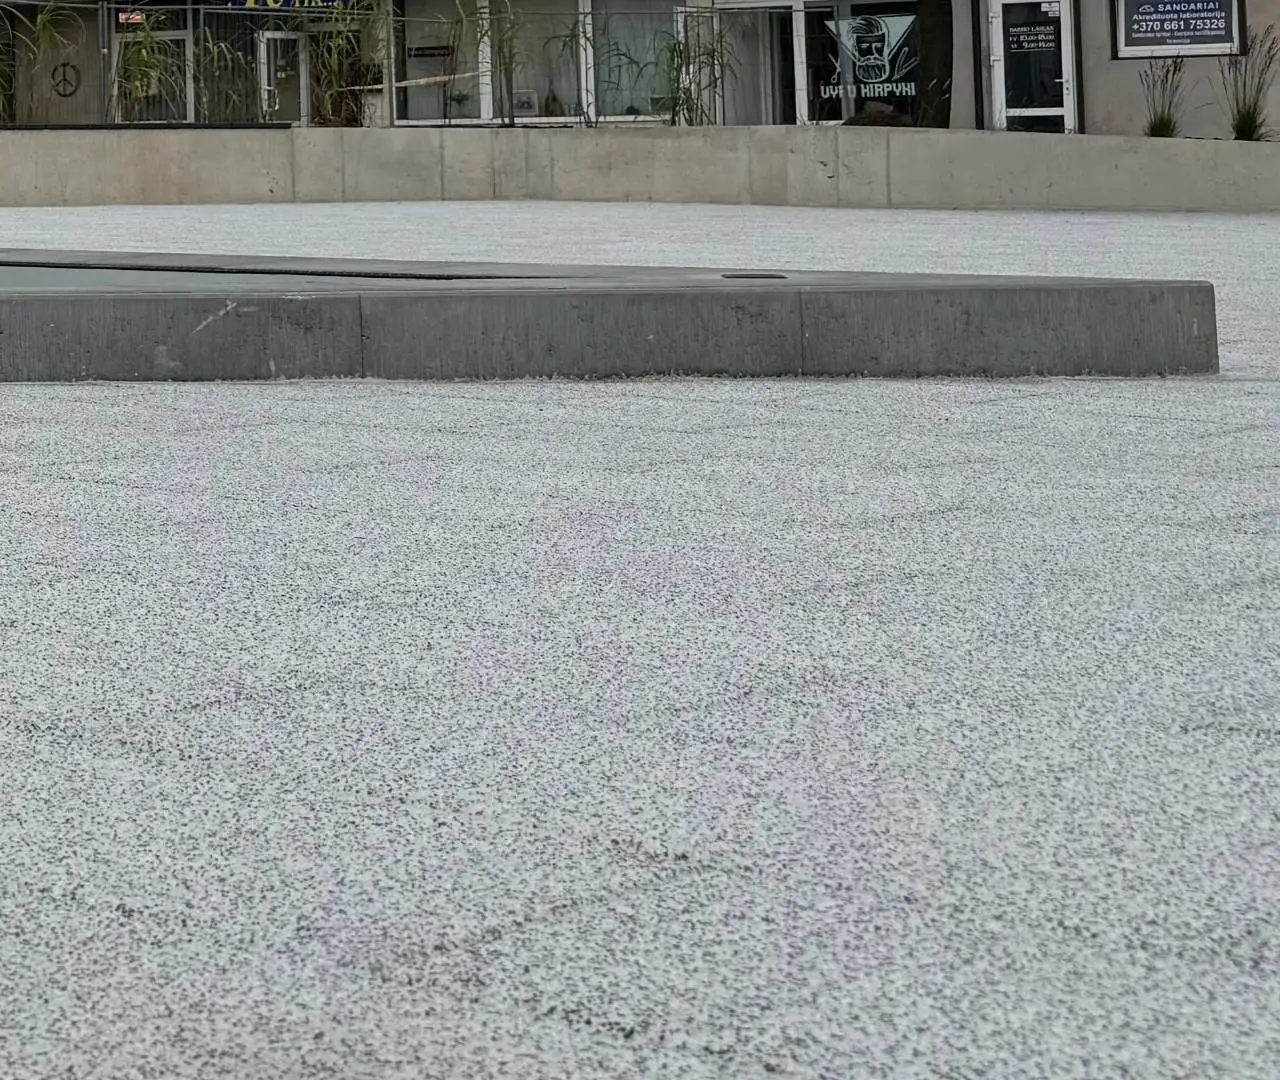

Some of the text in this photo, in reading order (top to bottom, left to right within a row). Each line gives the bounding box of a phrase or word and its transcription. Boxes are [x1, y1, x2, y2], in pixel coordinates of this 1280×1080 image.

[1158, 2, 1219, 11] SANDARIAI
[1132, 11, 1226, 21] Akredituota laboratorija
[1132, 19, 1226, 31] +370 661 75326
[860, 81, 917, 98] KIRPYK
